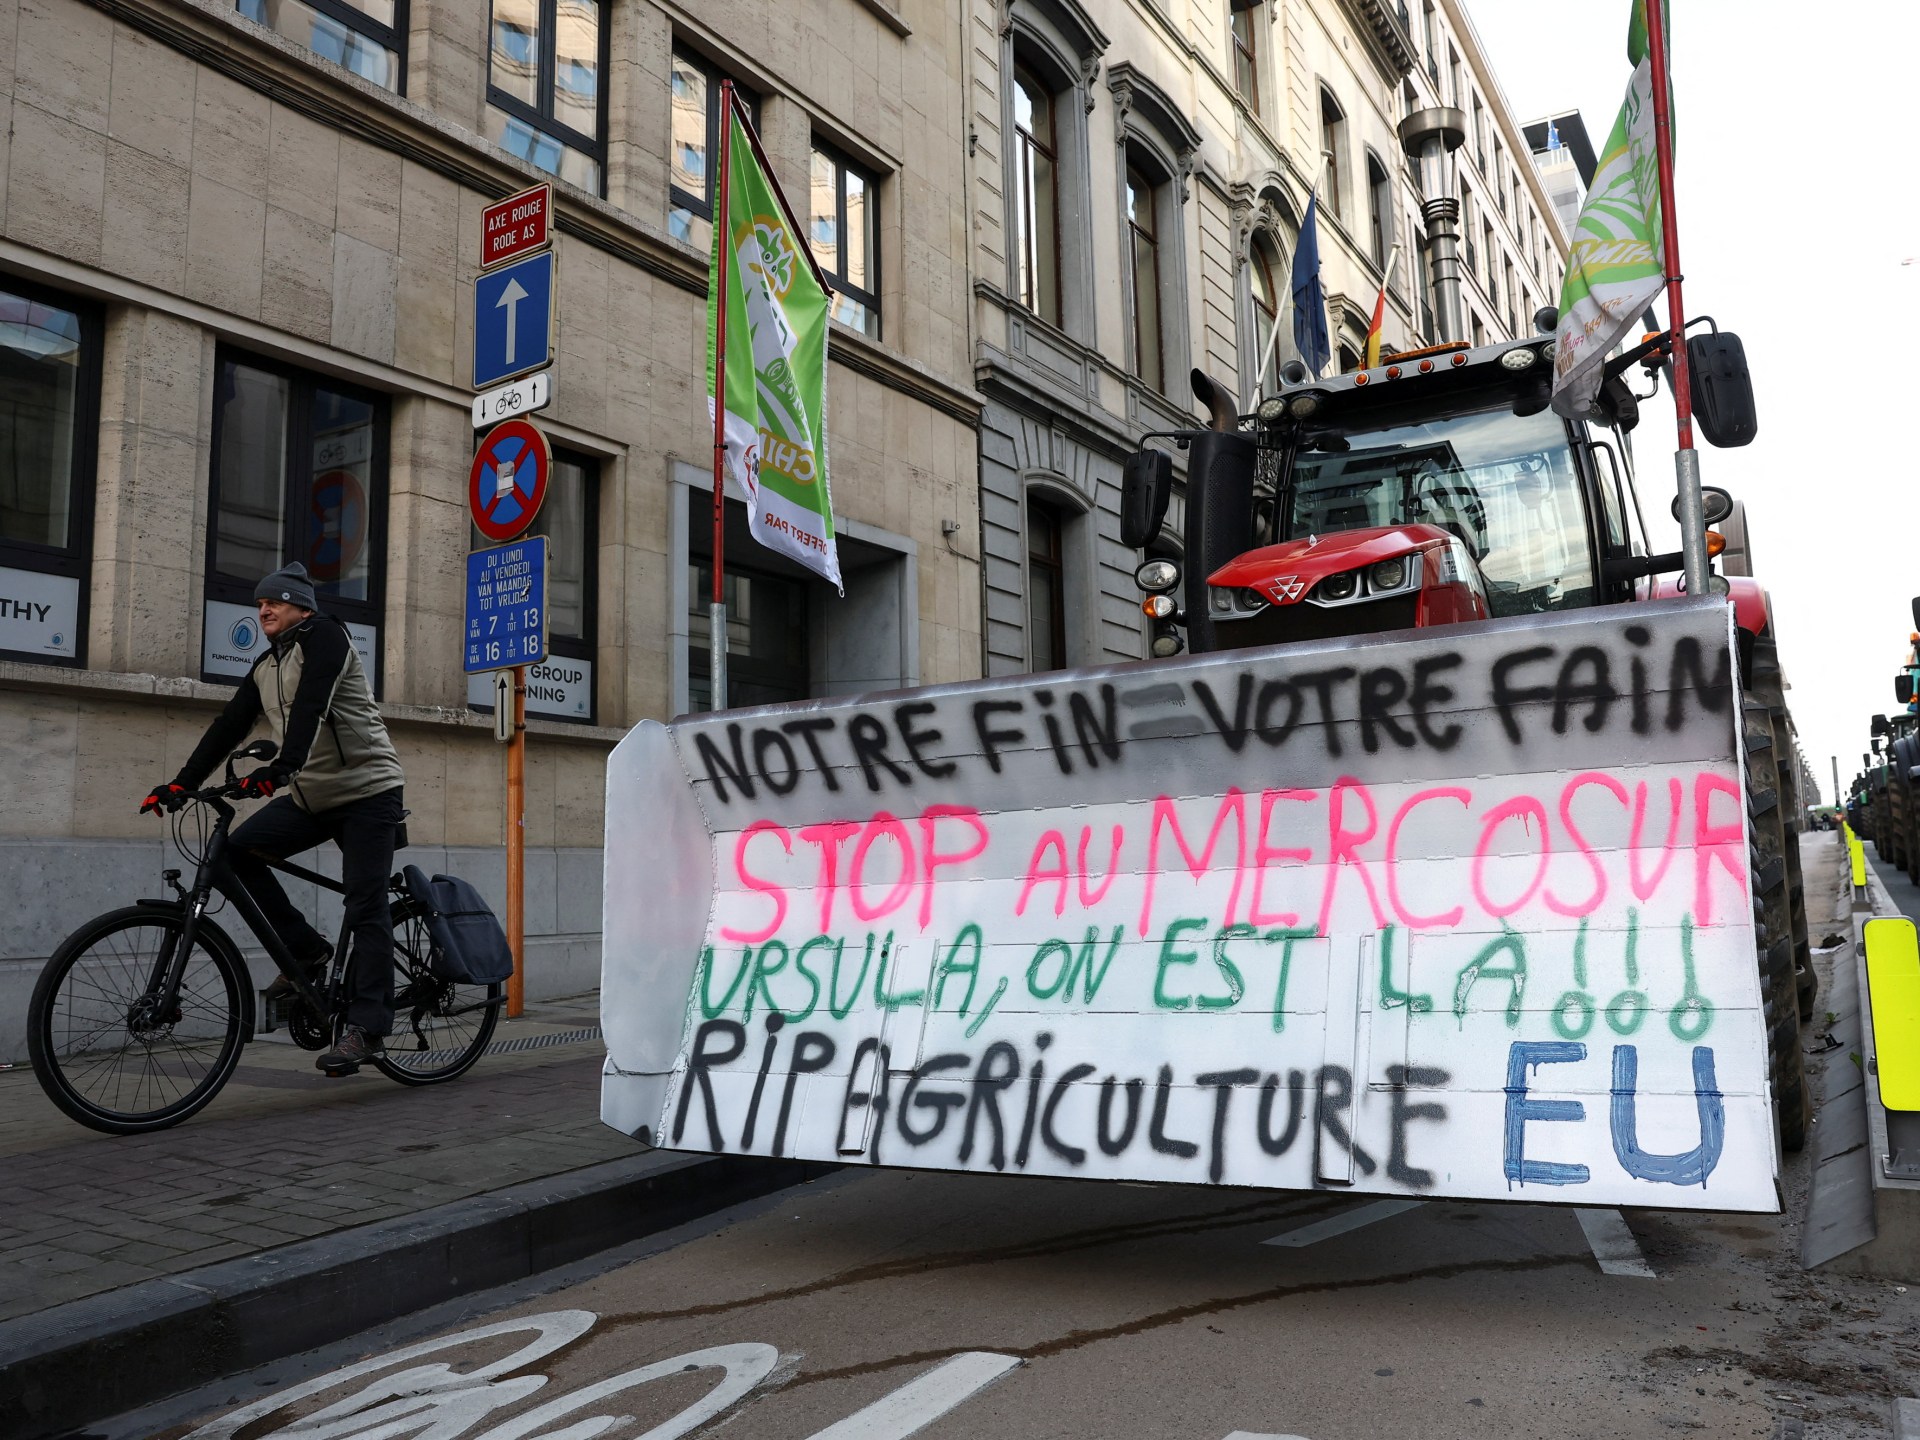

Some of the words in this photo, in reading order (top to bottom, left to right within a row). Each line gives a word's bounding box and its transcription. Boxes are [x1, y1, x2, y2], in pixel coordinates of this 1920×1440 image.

[488, 212, 507, 232] AXE
[512, 198, 542, 223] ROUGE
[493, 230, 517, 252] RODE
[522, 223, 535, 240] AS
[487, 554, 498, 568] DU
[501, 548, 523, 565] LUNDI
[480, 570, 490, 583] AU
[494, 561, 530, 580] VENDREDI
[477, 583, 492, 597] VAN
[496, 575, 532, 594] MAANDAG
[480, 597, 493, 611] TOT
[471, 618, 479, 629] DE
[489, 615, 498, 635] 7
[507, 621, 517, 632] TOT
[523, 607, 539, 629] 13
[470, 628, 480, 639] VAN
[470, 644, 478, 654] DE
[485, 641, 500, 662] 16
[506, 648, 517, 659] TOT
[523, 634, 539, 656] 18
[211, 653, 252, 664] FUNCTIONAL
[469, 655, 480, 665] VAN
[530, 664, 583, 685] GROUP
[694, 703, 957, 803] NOTRE
[1191, 651, 1463, 758] VOTRE
[719, 804, 990, 944] STOP
[1014, 824, 1124, 918] AU
[1138, 771, 1747, 940] MERCOSUR
[1026, 924, 1124, 1005] ON
[1153, 917, 1321, 1032] EST
[1502, 1040, 1726, 1192] EU
